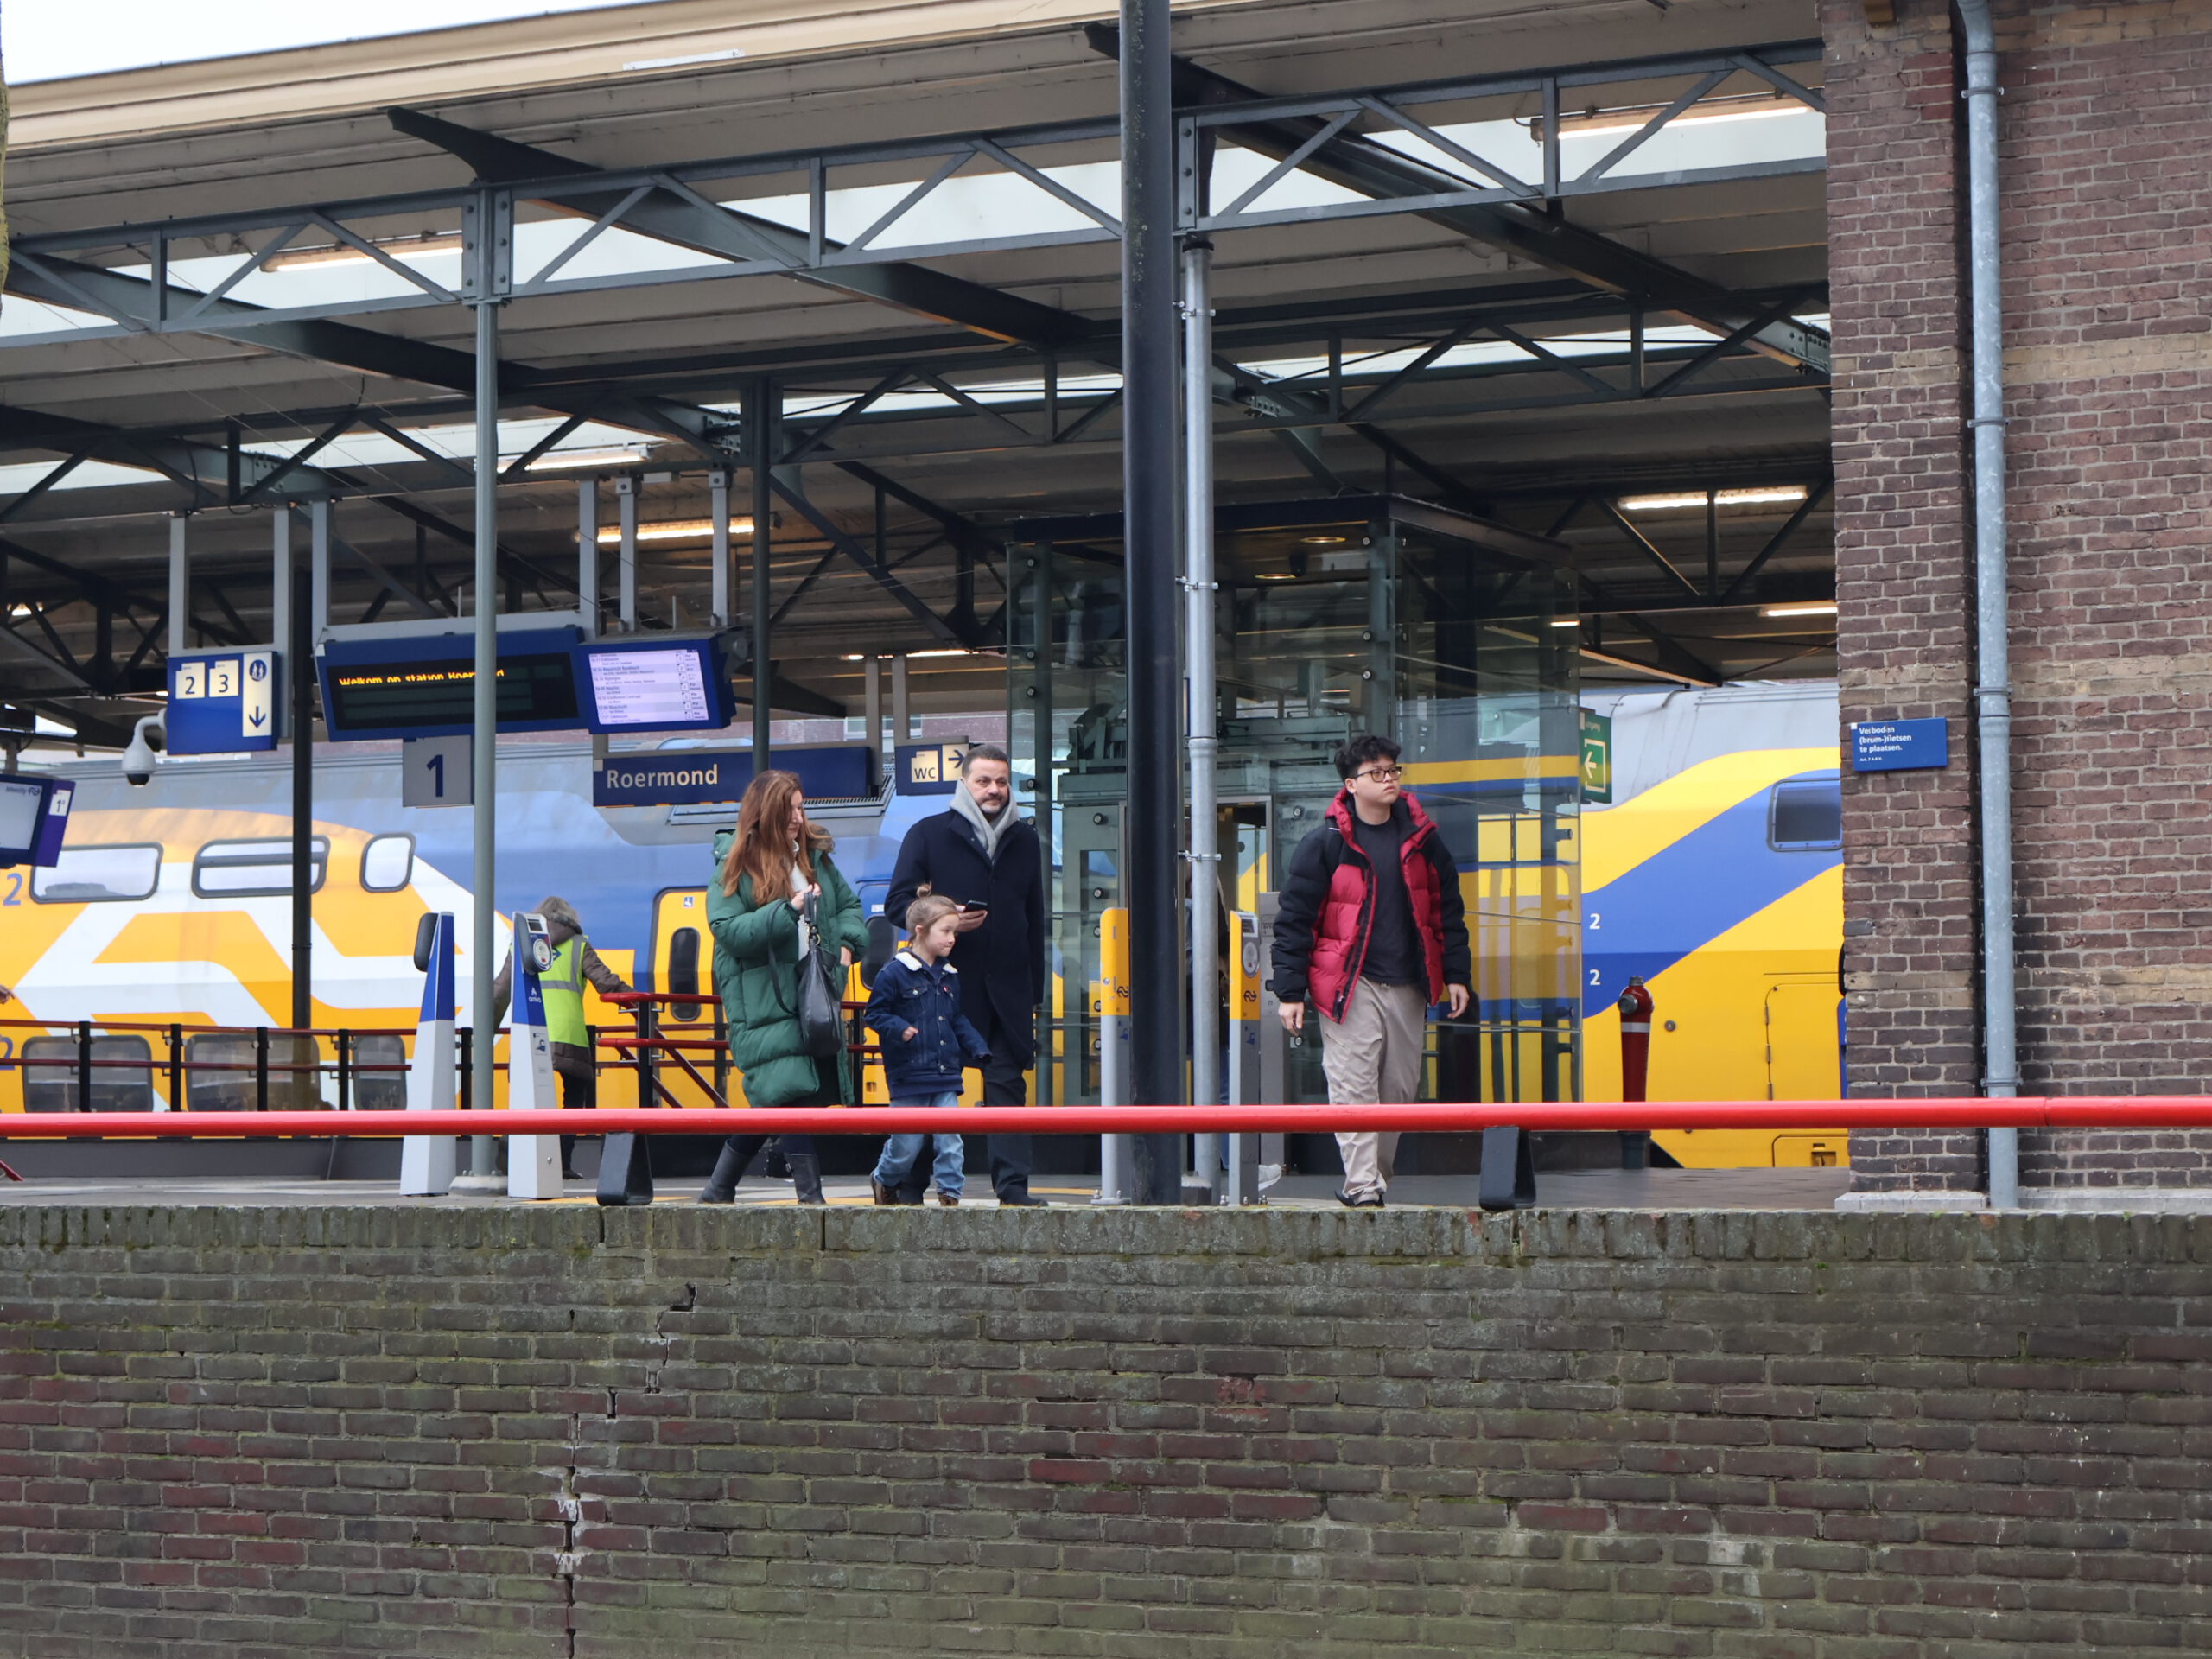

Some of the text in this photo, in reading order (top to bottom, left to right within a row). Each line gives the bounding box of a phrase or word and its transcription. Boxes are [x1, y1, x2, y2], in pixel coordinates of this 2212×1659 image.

[185, 676, 195, 695] 2
[218, 674, 229, 693] 3
[1859, 726, 1896, 734] Verboden
[1869, 745, 1903, 753] plaatsen.
[427, 754, 444, 798] 1
[607, 763, 718, 789] Roermond
[914, 767, 936, 779] WC
[3, 872, 23, 906] 2
[1589, 912, 1601, 930] 2
[1589, 969, 1601, 986] 2
